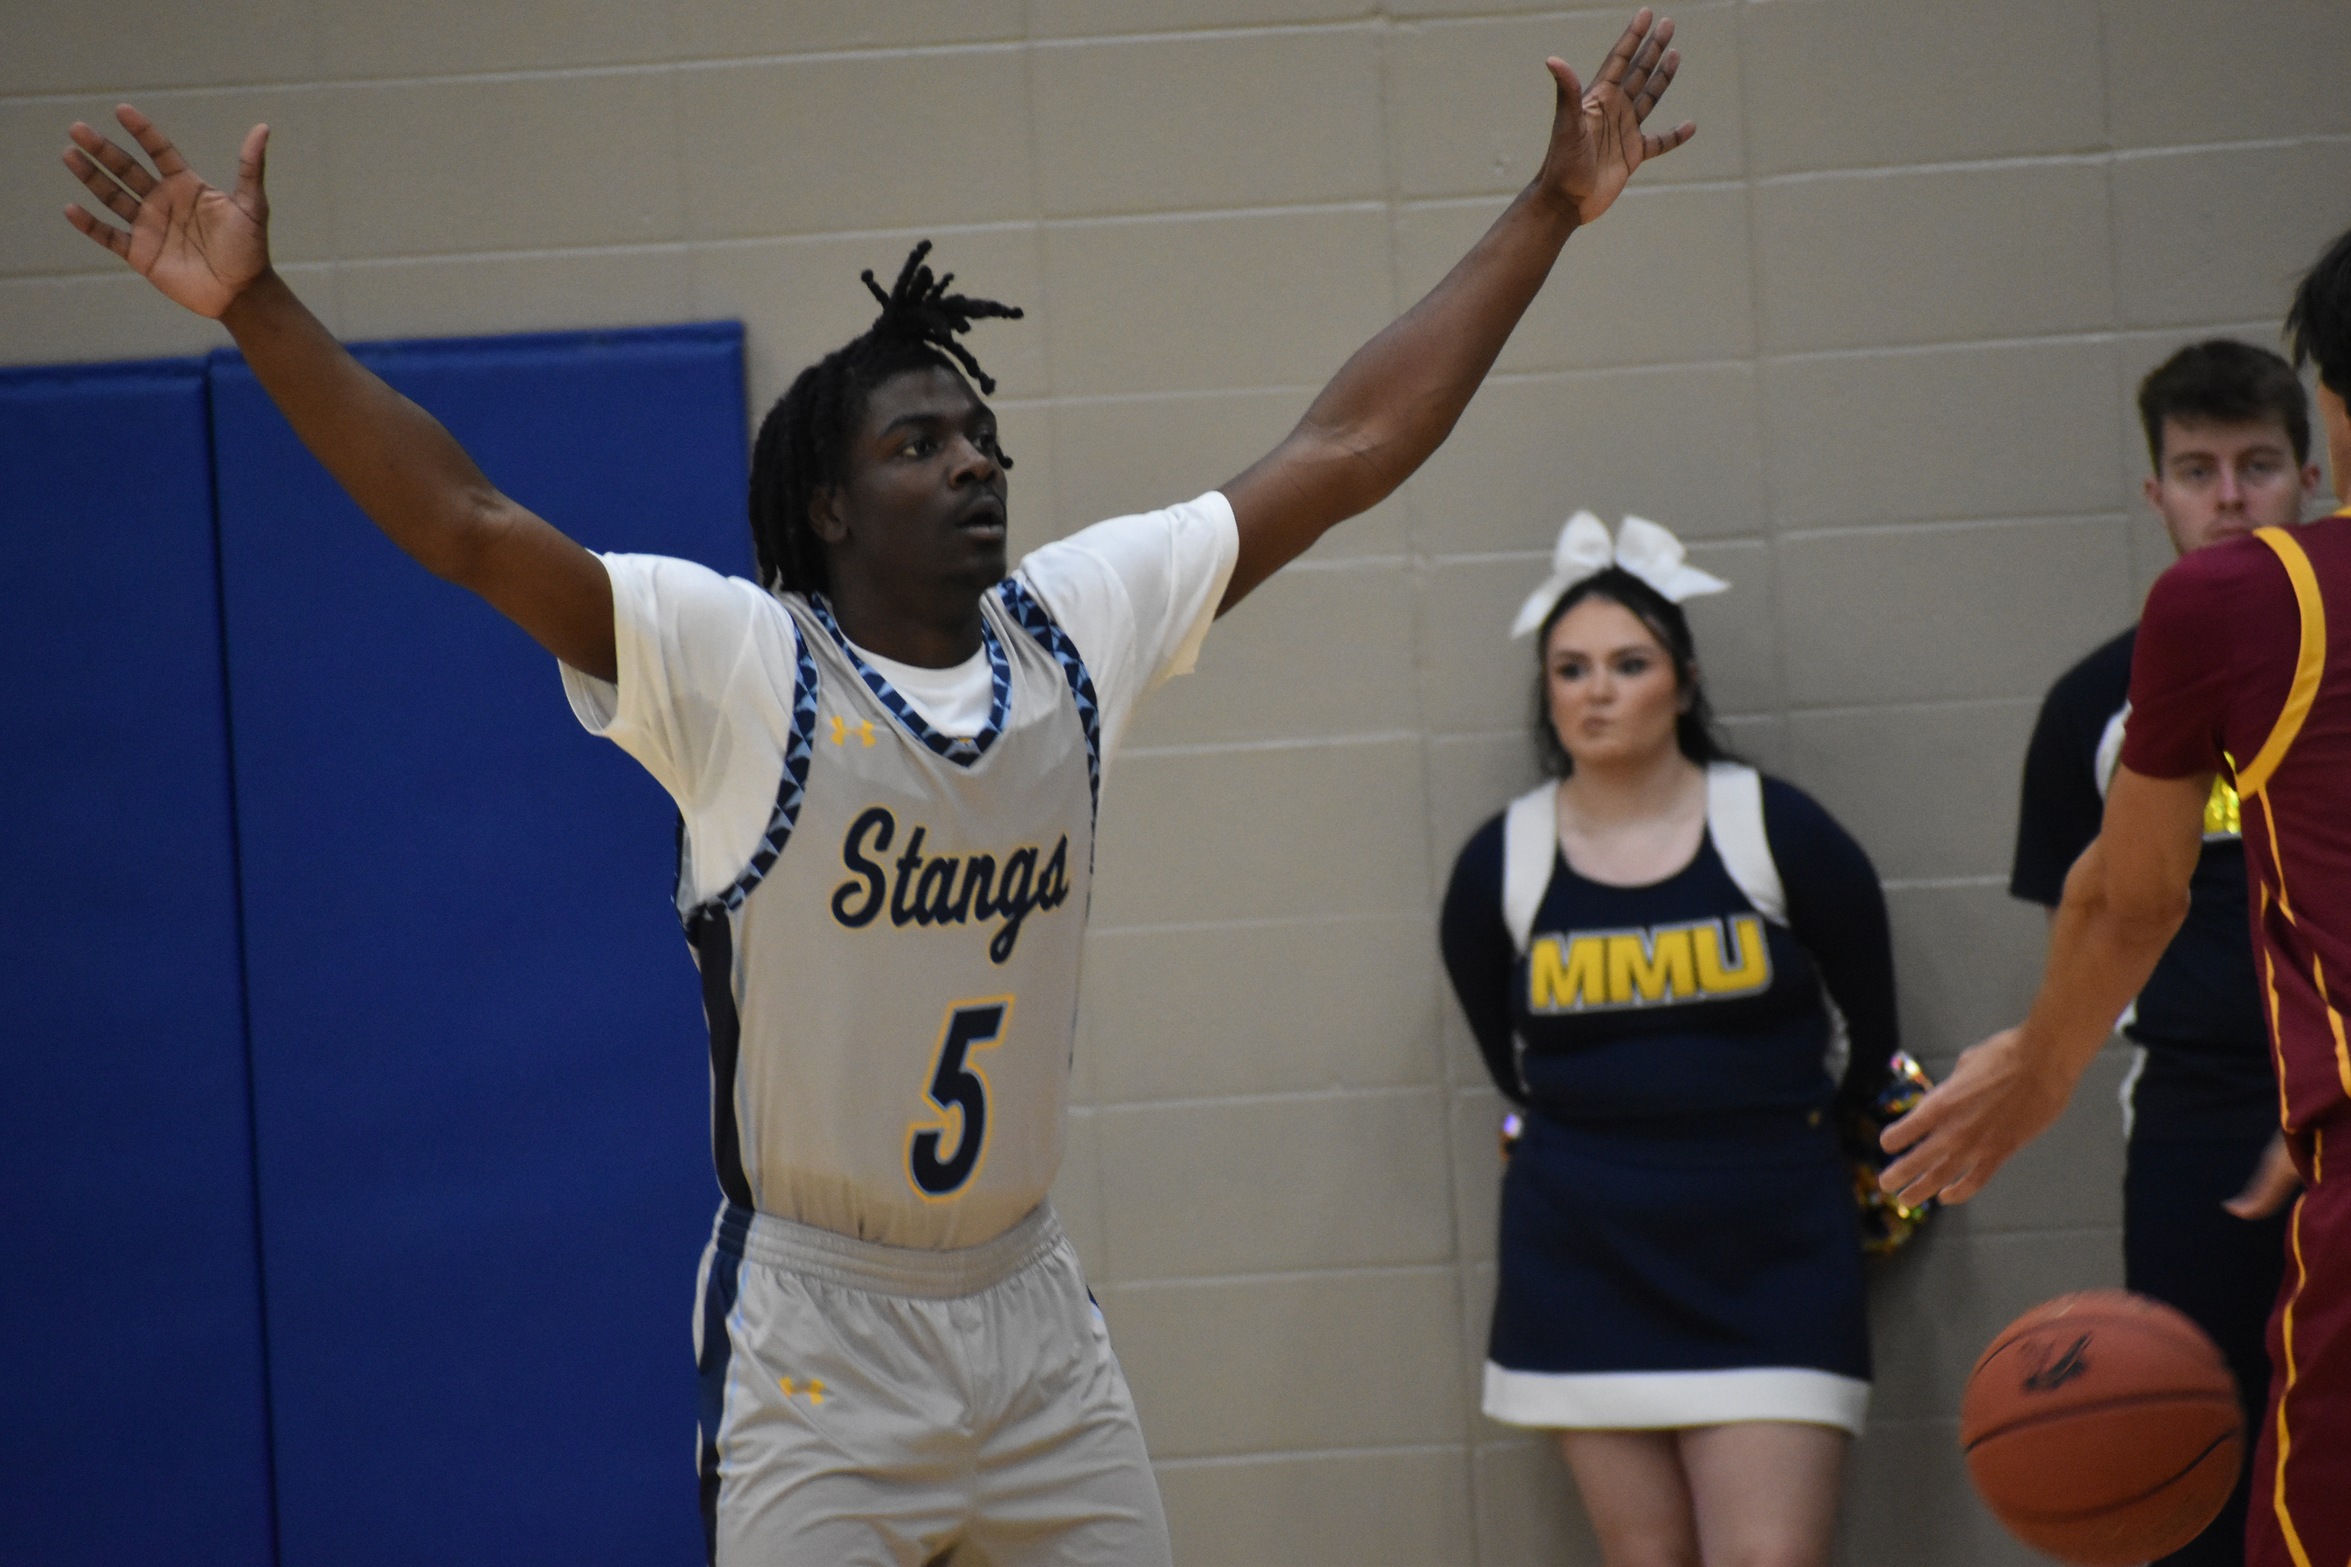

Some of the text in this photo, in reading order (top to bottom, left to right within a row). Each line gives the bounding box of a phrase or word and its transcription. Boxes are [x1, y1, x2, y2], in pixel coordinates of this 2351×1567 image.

[831, 805, 1071, 964] Stangs
[1528, 911, 1773, 1015] MMU
[906, 994, 1014, 1203] 5
